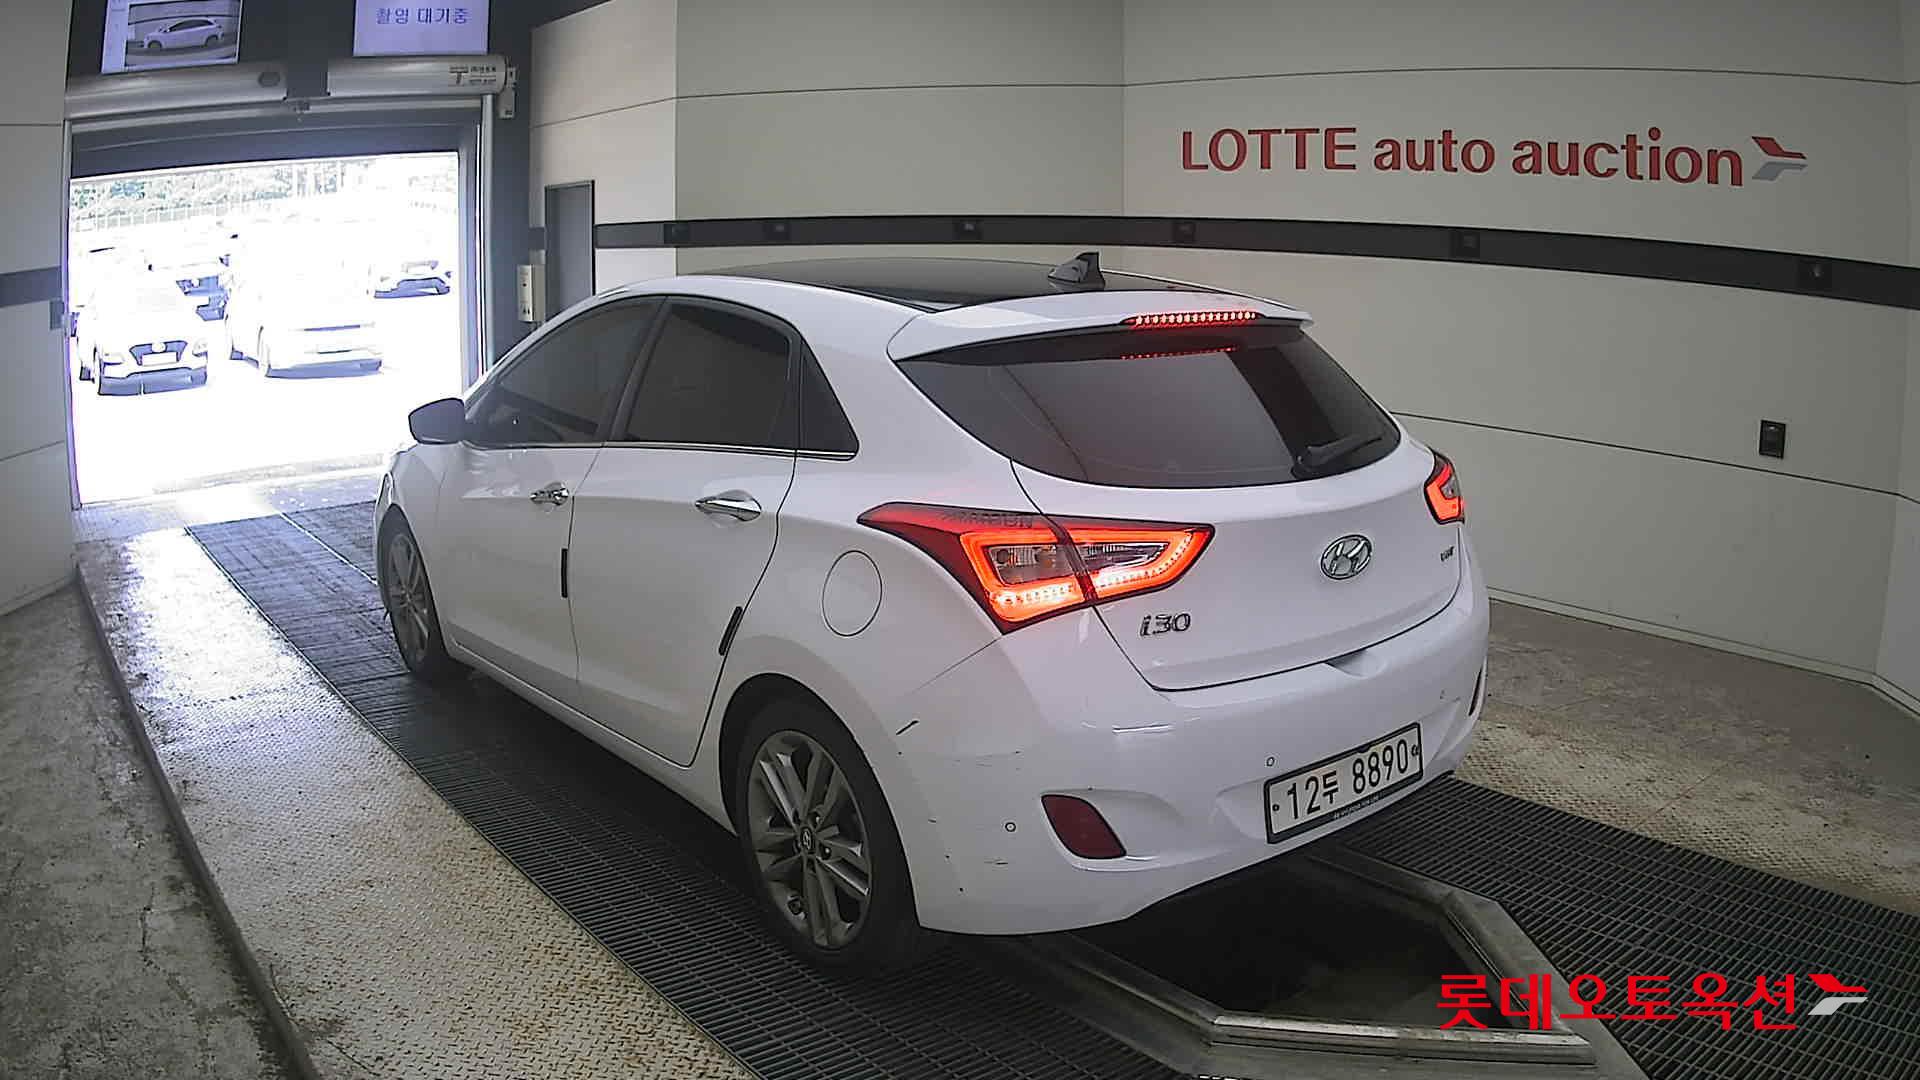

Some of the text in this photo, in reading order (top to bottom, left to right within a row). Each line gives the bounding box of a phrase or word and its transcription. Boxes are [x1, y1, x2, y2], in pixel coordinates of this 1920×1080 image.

[376, 7, 468, 25] 촬영 대기중
[1181, 126, 1744, 187] LOTTE auto auction
[1140, 613, 1191, 637] i30
[1286, 770, 1339, 820] 12두
[1352, 738, 1409, 795] 8890
